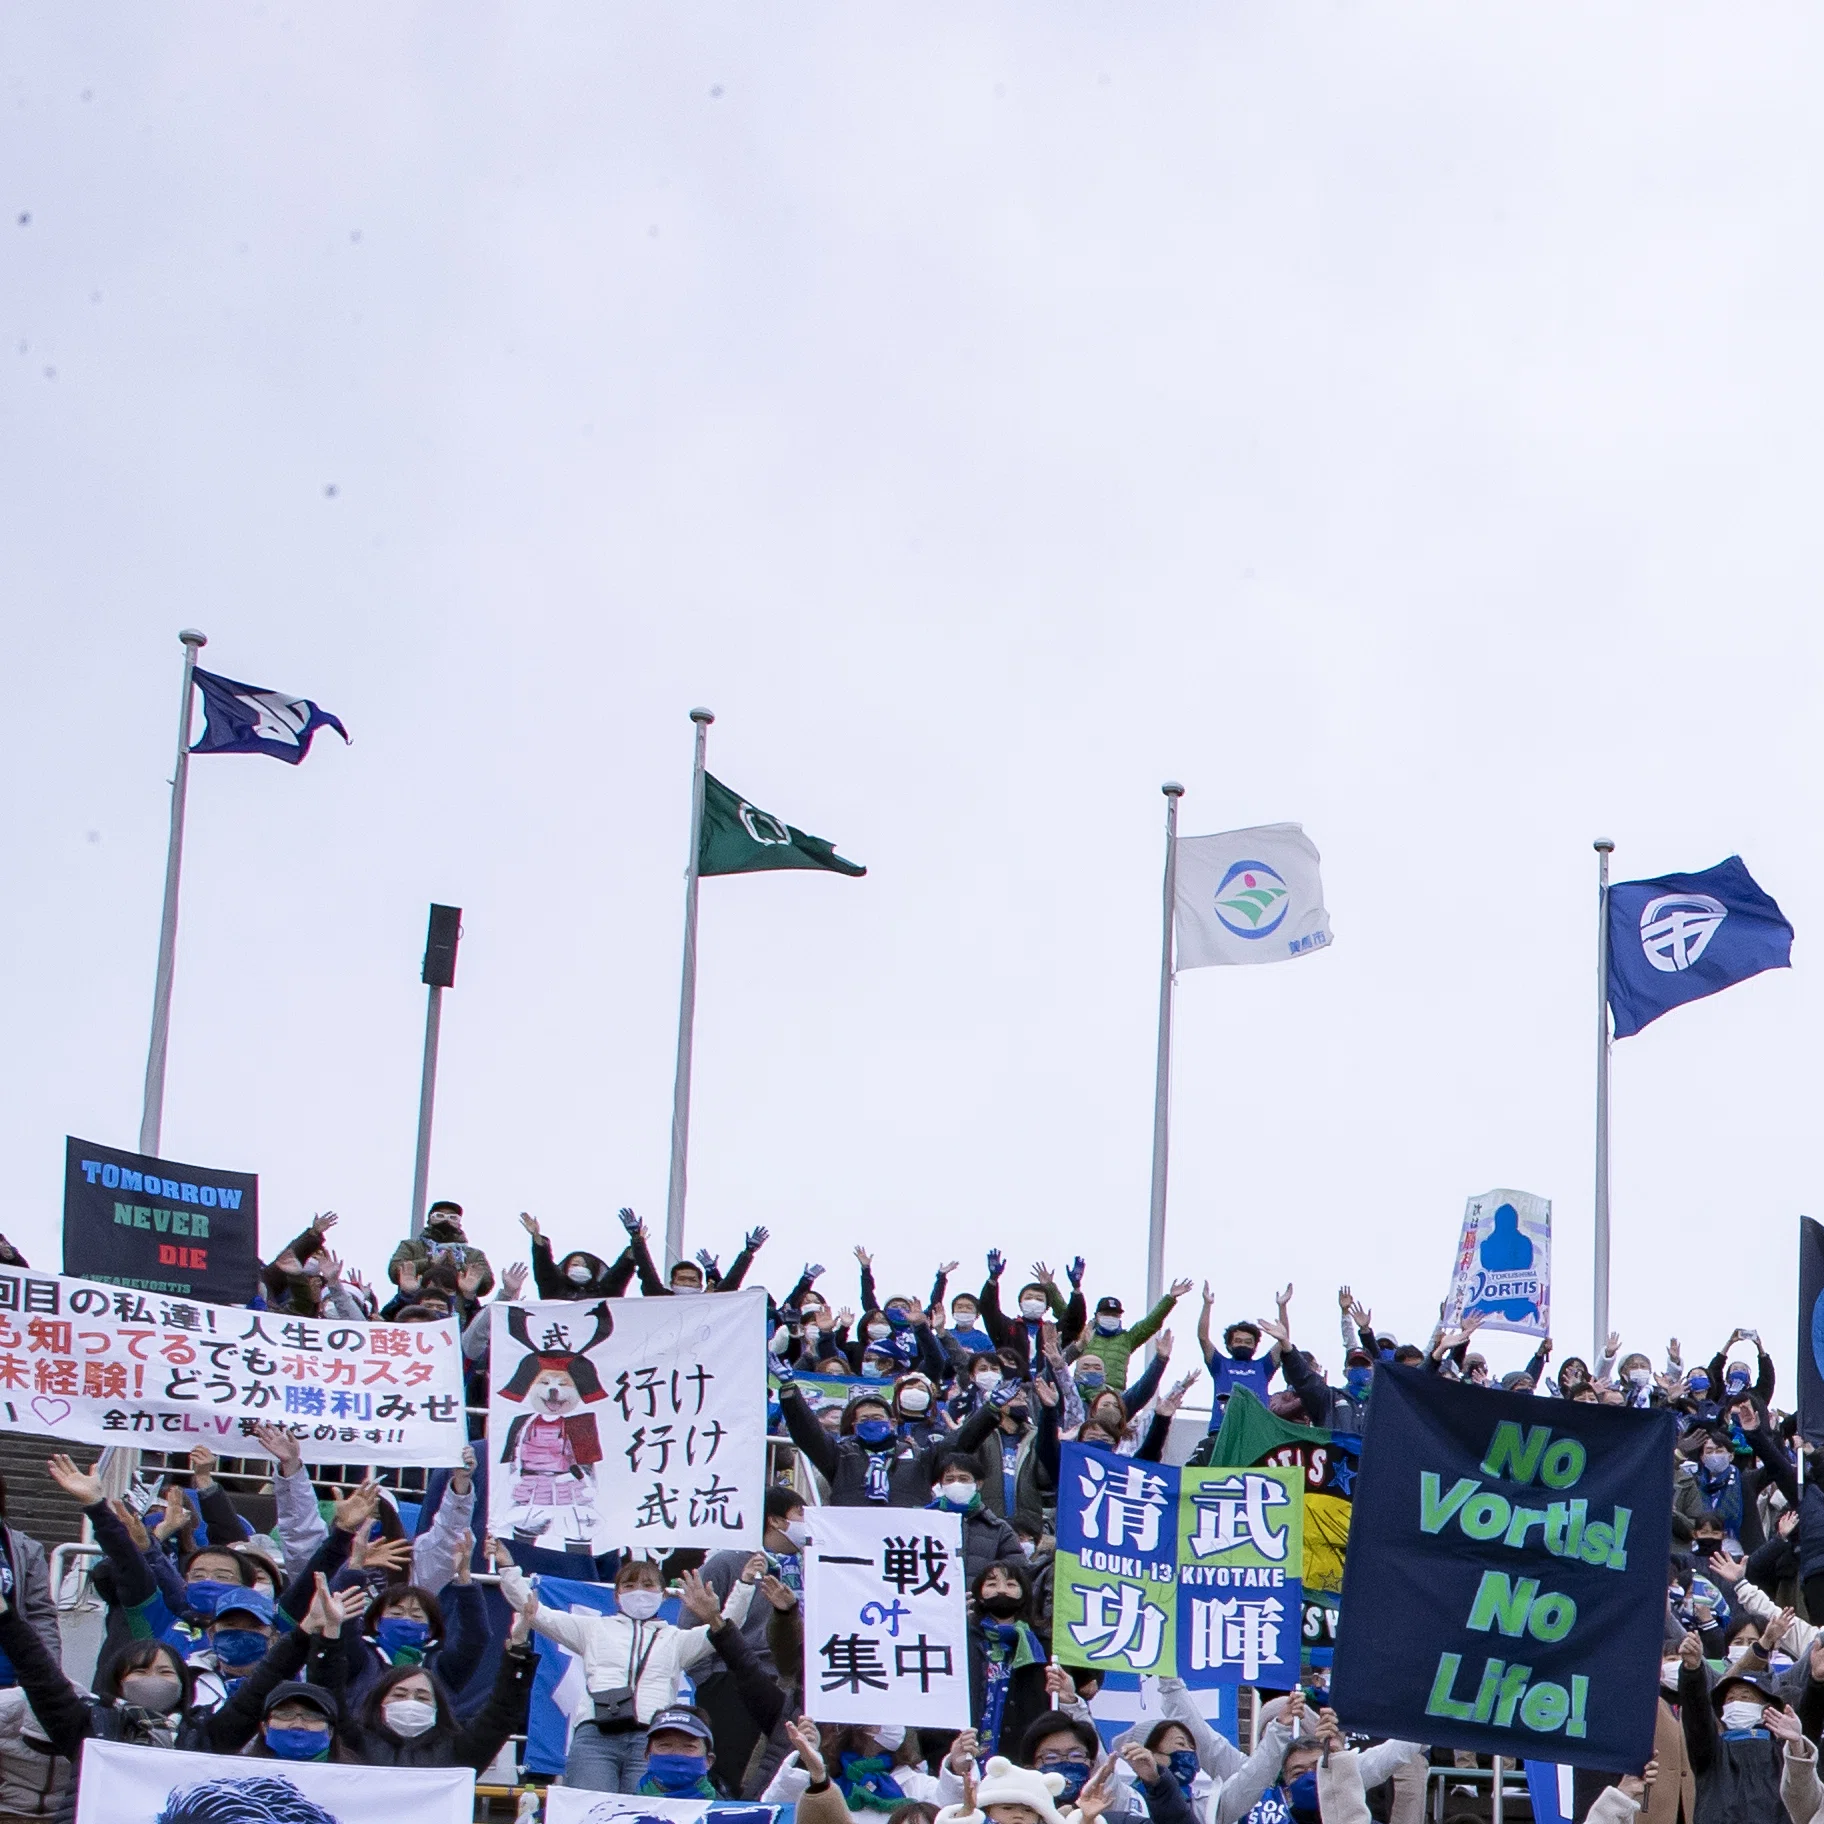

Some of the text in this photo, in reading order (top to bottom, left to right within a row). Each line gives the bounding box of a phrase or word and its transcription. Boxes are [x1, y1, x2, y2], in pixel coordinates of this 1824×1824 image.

[81, 1159, 243, 1210] TOMORROW
[113, 1202, 209, 1238] NEVER
[158, 1243, 208, 1270] DIE
[239, 1314, 453, 1353] 人生の酸い
[542, 1322, 574, 1353] 武
[164, 1366, 460, 1424] どうか勝利みせ
[613, 1364, 714, 1420] 行け
[625, 1420, 726, 1476] 行け
[1479, 1420, 1586, 1489] No
[634, 1475, 745, 1533] 武流
[1420, 1470, 1633, 1571] Vortis!
[1081, 1548, 1285, 1588] KOUKI 13 KIYOTAKE
[1466, 1570, 1577, 1643] No
[819, 1633, 953, 1695] 集中
[1424, 1651, 1590, 1739] Life!
